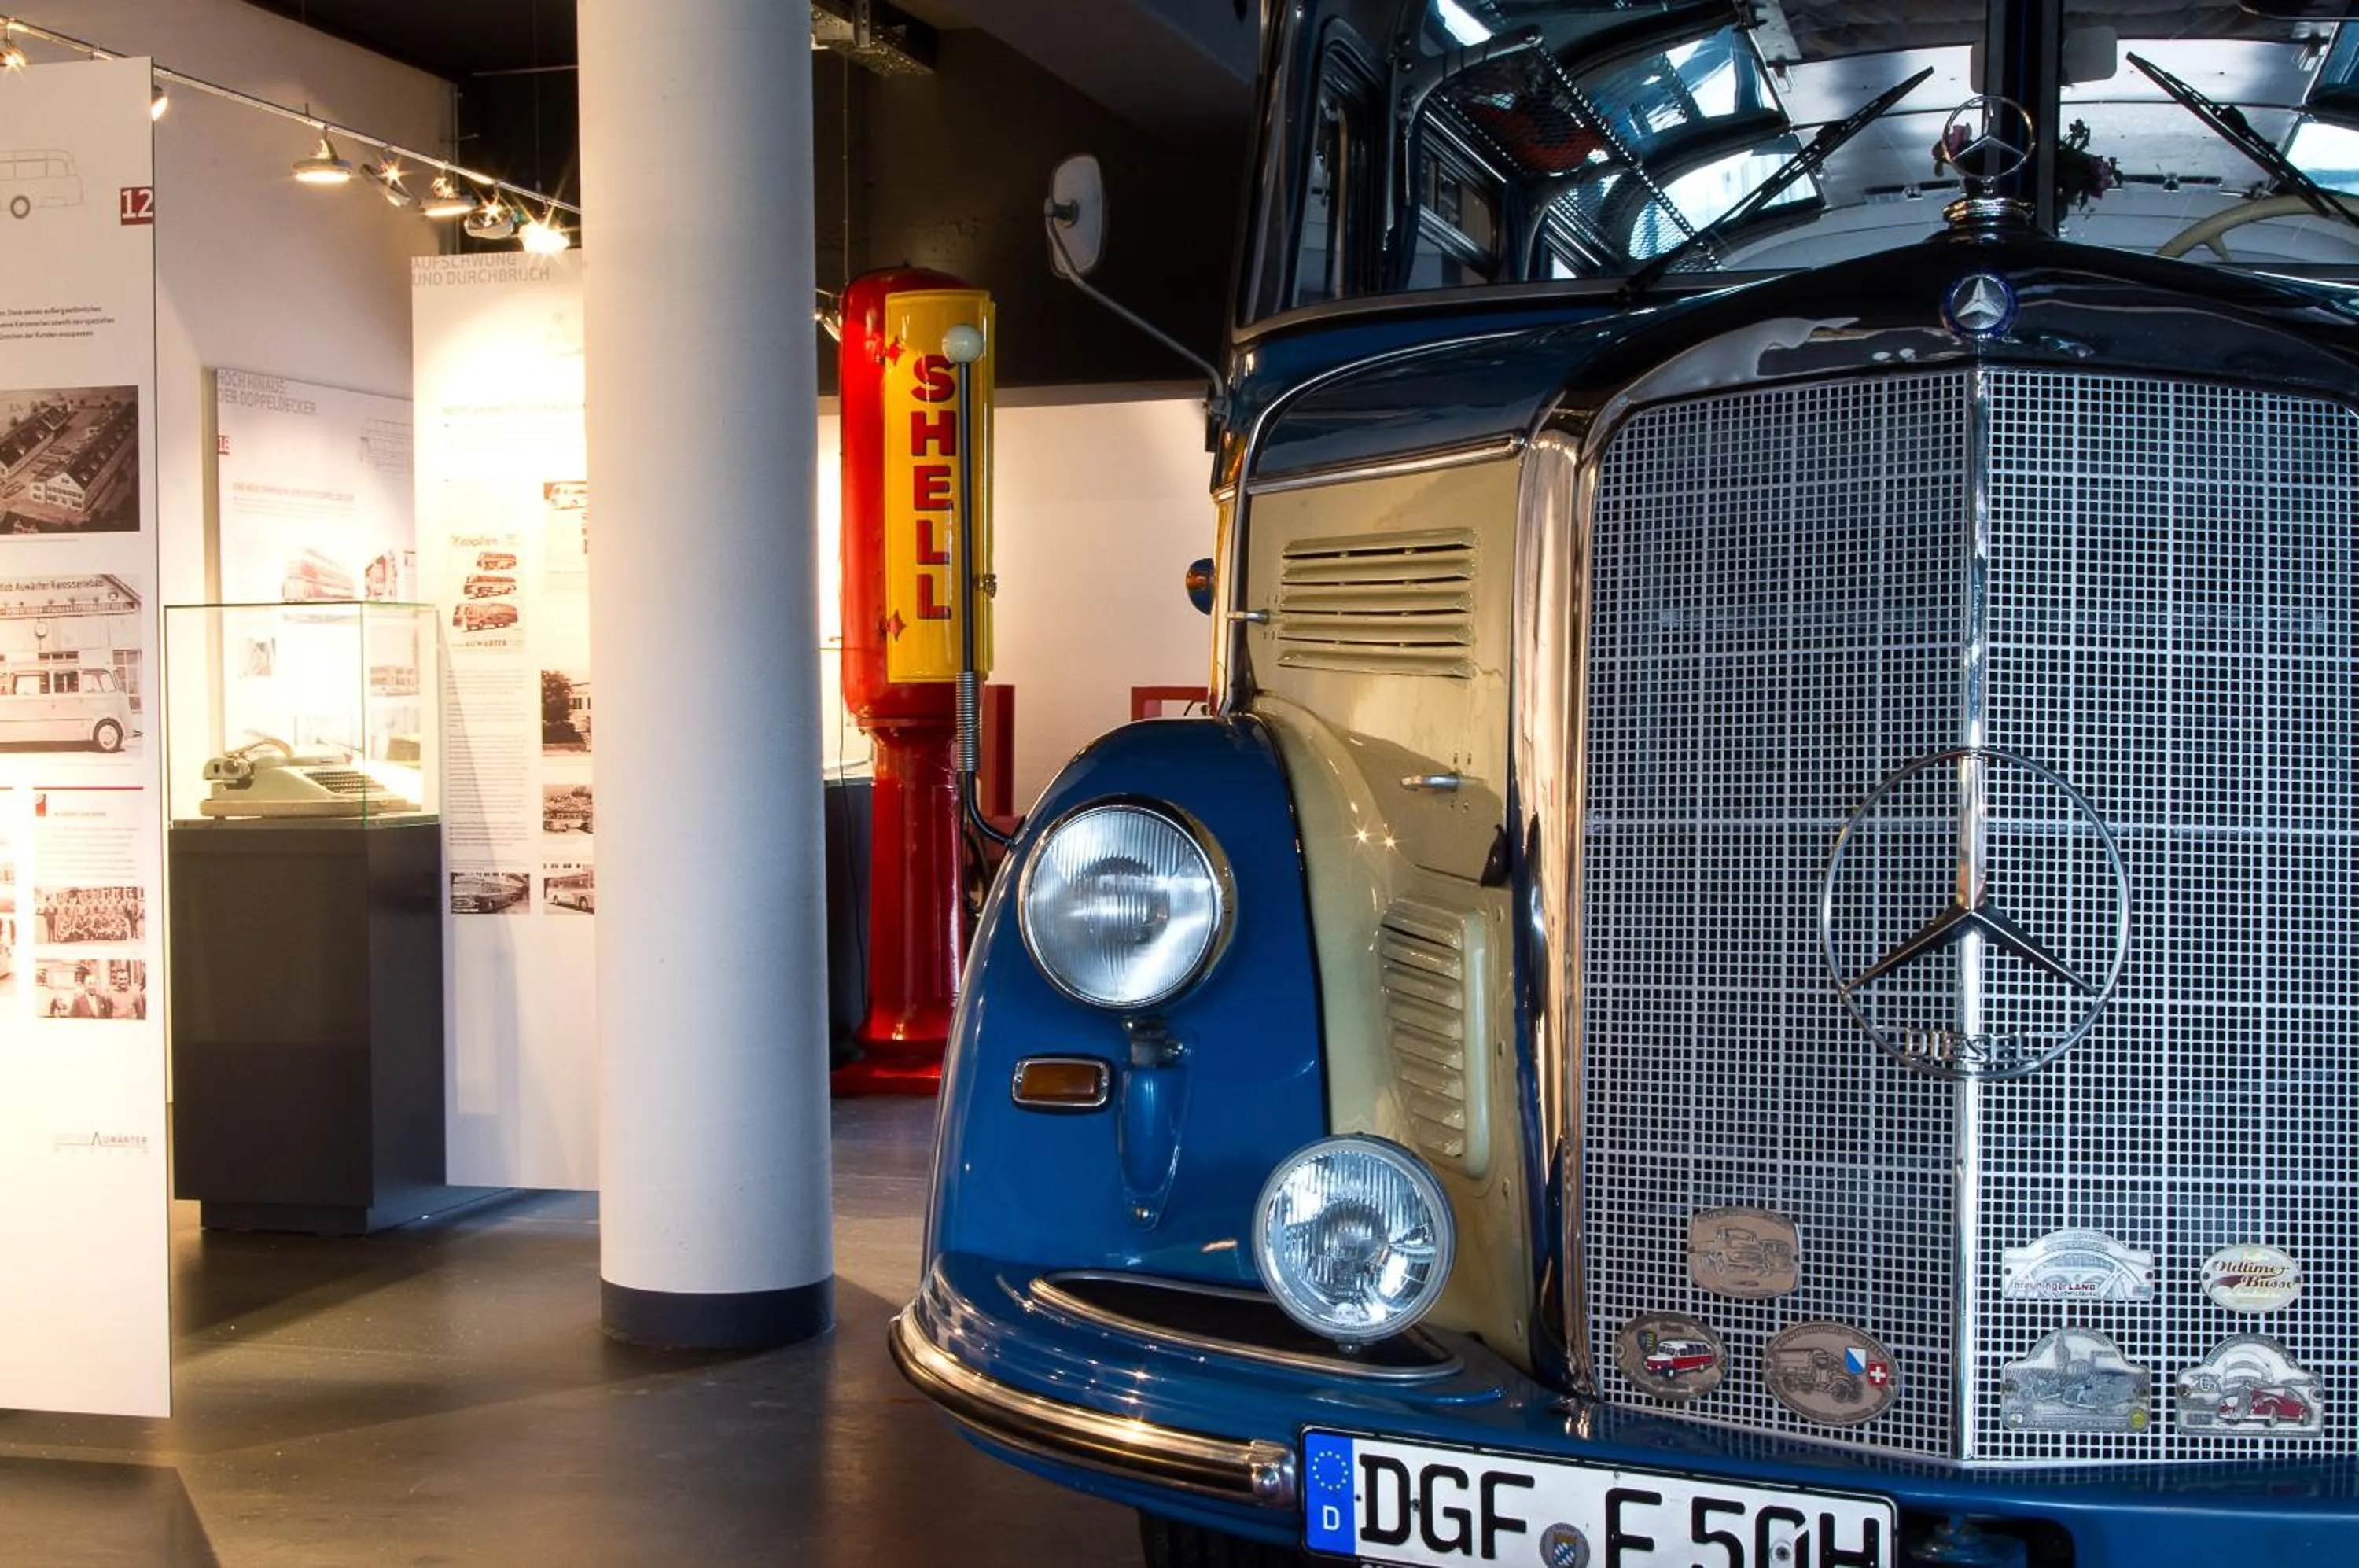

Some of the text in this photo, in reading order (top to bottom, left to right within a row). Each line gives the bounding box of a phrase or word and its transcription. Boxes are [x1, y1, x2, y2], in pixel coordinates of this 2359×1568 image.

[122, 187, 153, 219] 12
[413, 252, 517, 271] AUFSCHWUNG
[412, 266, 550, 287] UND DURCHBRUCH
[240, 389, 317, 416] DOPPELDECKER
[910, 354, 957, 620] SHELL
[1904, 1027, 2038, 1063] DIESEL
[2213, 1260, 2290, 1275] Oldtimer
[1323, 1504, 1340, 1531] D
[1359, 1453, 1535, 1560] DGF
[1691, 1496, 1880, 1568] 50H
